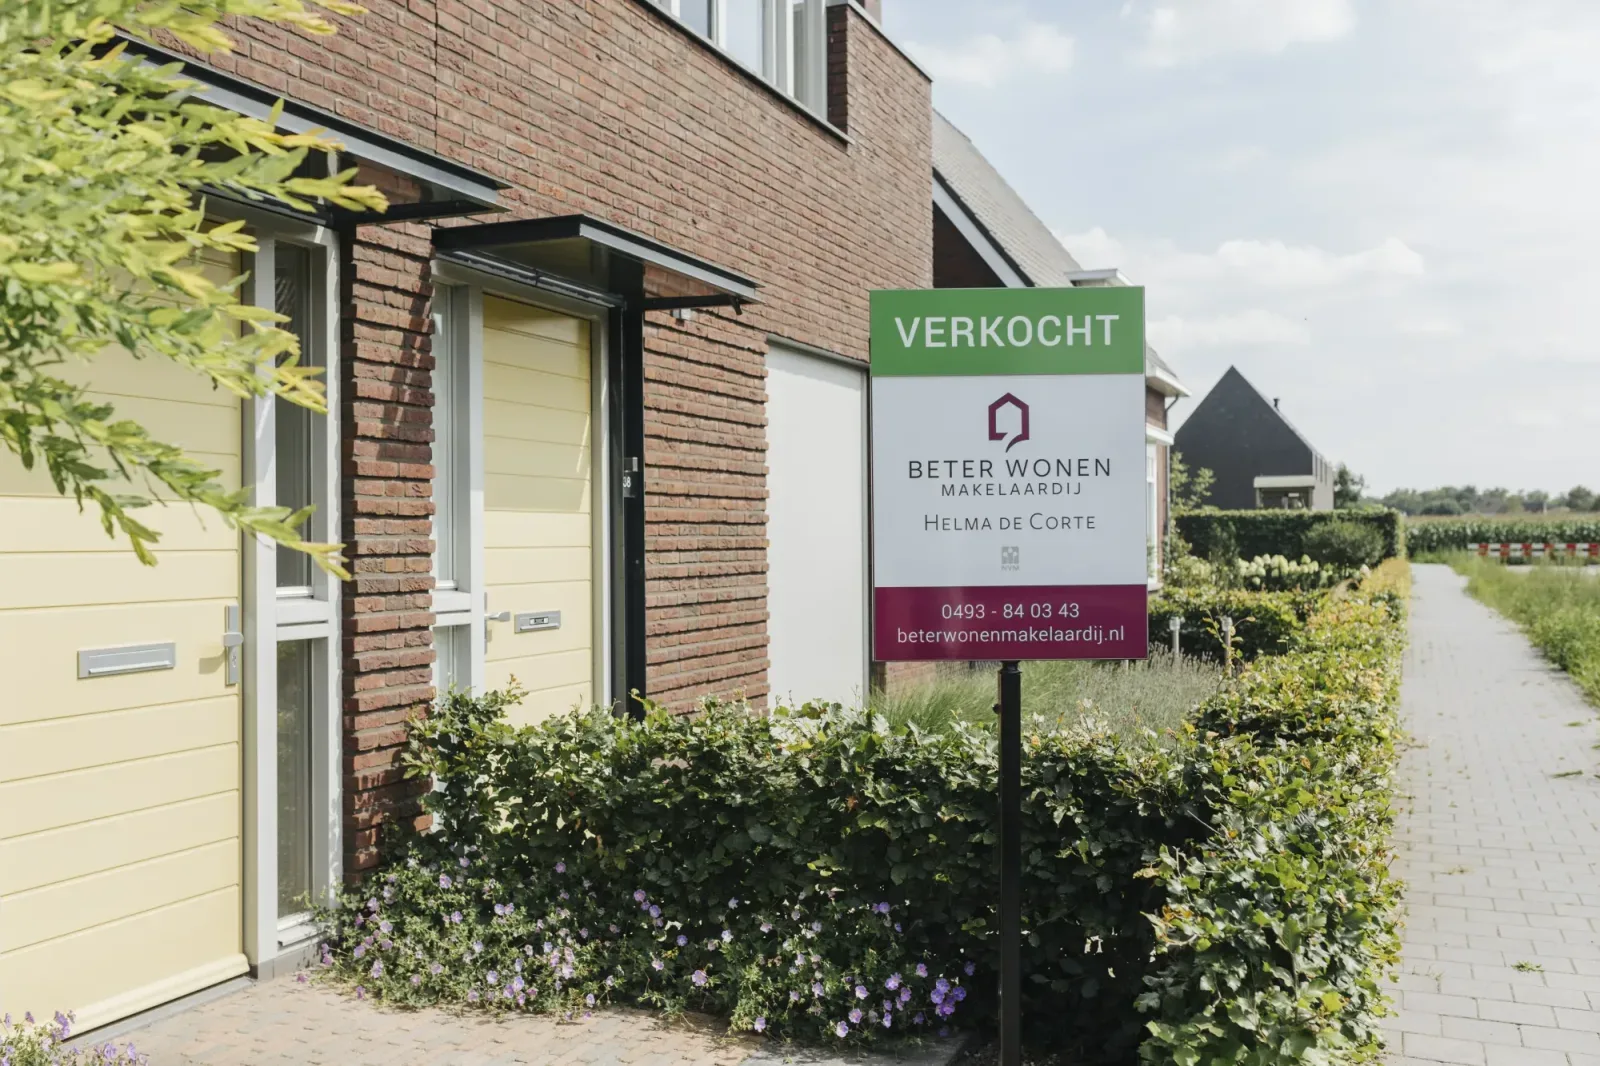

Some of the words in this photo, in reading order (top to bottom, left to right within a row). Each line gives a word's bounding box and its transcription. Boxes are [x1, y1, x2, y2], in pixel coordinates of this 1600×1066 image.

[894, 315, 1120, 348] VERKOCHT
[908, 459, 994, 479] BETER
[1005, 458, 1111, 478] WONEN
[941, 482, 1081, 497] MAKELAARDIJ
[941, 603, 985, 620] 0493
[1003, 603, 1025, 619] 84
[1030, 602, 1052, 619] 03
[1058, 602, 1080, 618] 43
[897, 625, 1125, 645] beterwonenmakelaardij.nl
